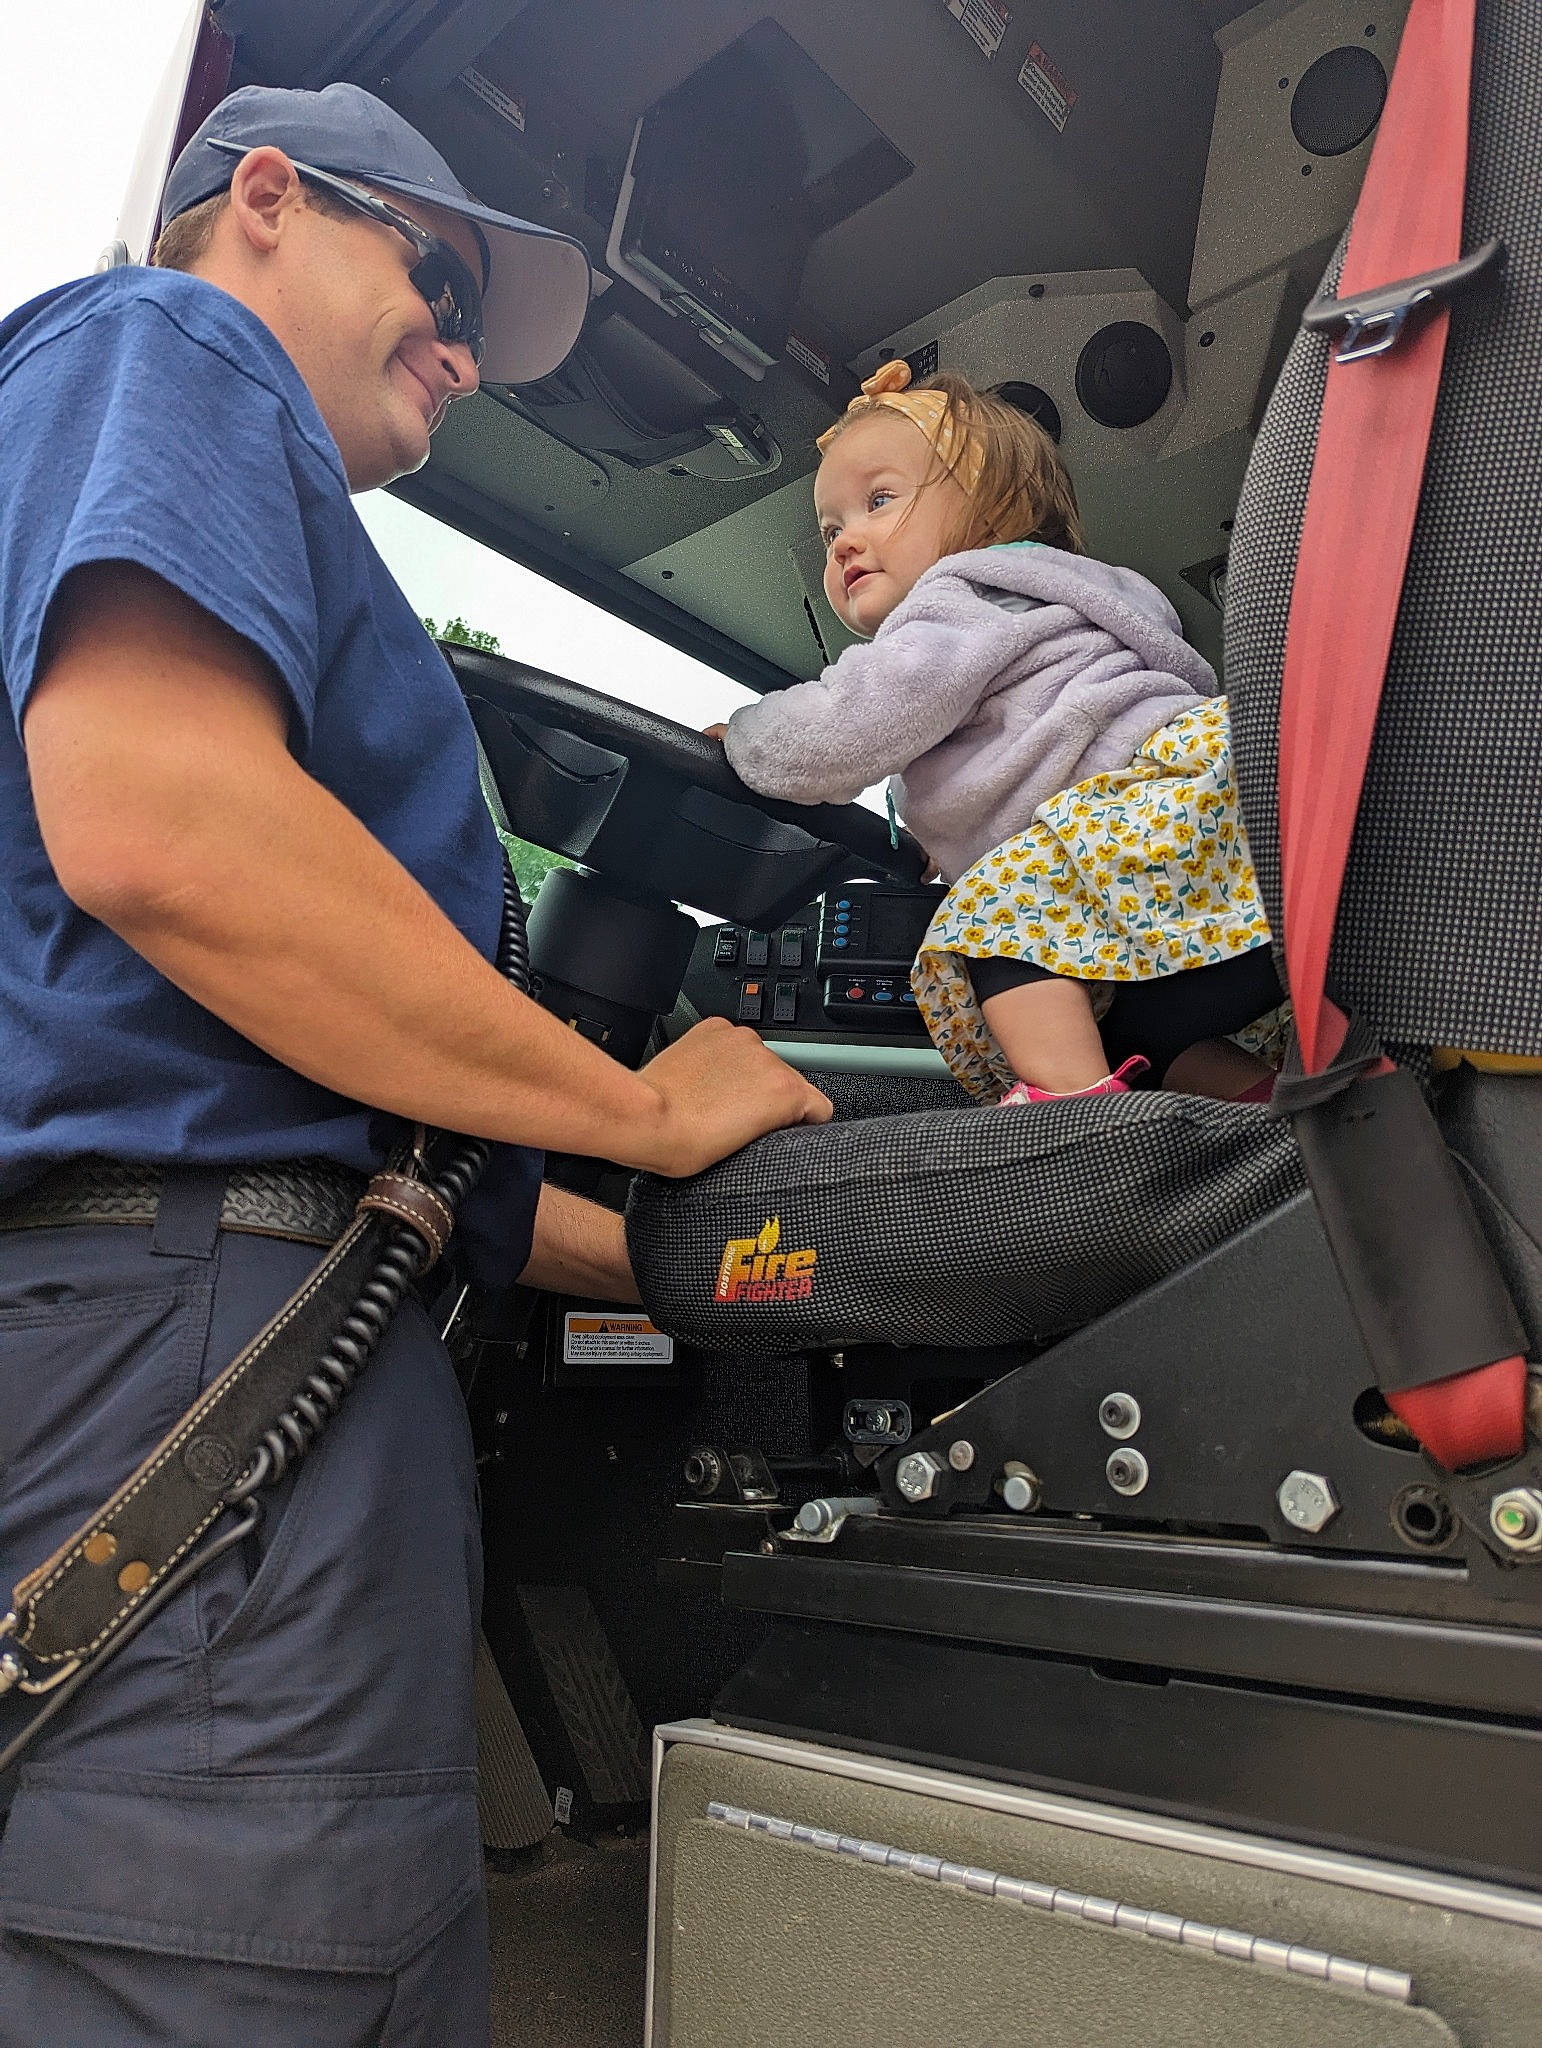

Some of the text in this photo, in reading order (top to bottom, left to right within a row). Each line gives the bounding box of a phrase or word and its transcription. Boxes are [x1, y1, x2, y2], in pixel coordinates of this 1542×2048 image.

[715, 1237, 817, 1302] Fire
[719, 1245, 737, 1297] BOSTROM
[736, 1278, 813, 1302] FIGHTER
[609, 1323, 643, 1332] WARNING
